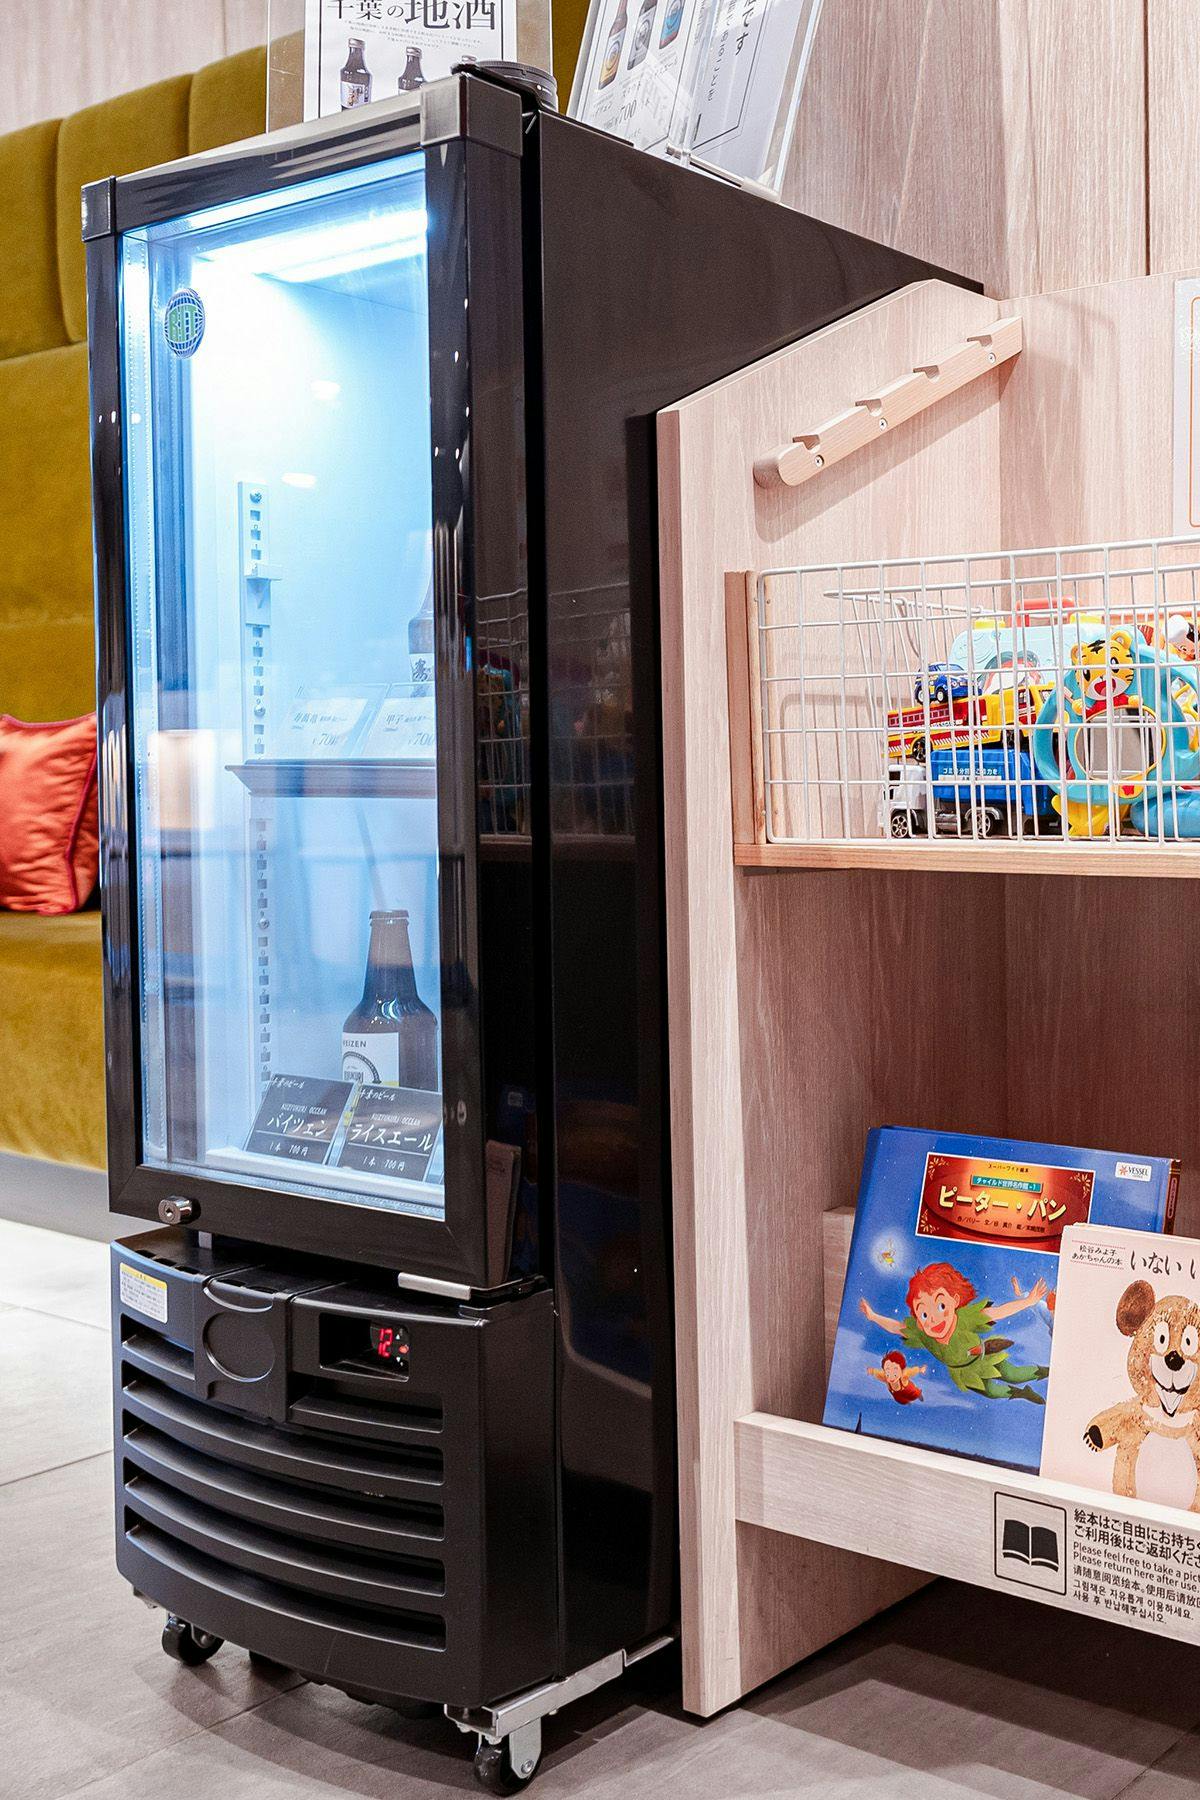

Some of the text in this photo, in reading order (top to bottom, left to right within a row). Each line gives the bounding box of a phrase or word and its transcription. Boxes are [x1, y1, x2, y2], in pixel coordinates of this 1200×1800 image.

[266, 1112, 329, 1137] バイツェン
[350, 1123, 433, 1152] ライスエール
[939, 1185, 1067, 1222] ピーター・パン
[1130, 1248, 1183, 1276] いない
[1073, 1542, 1102, 1557] Please
[1103, 1549, 1121, 1562] feel
[1122, 1553, 1142, 1567] free
[1142, 1559, 1152, 1569] to
[1153, 1561, 1175, 1575] take
[1175, 1570, 1182, 1578] a
[1073, 1552, 1200, 1593] Please return here after use.
[1073, 1579, 1194, 1621] 그림책은 자유롭게 이용하세요.
[1073, 1590, 1167, 1625] 사용 후 반납해주십시오.
